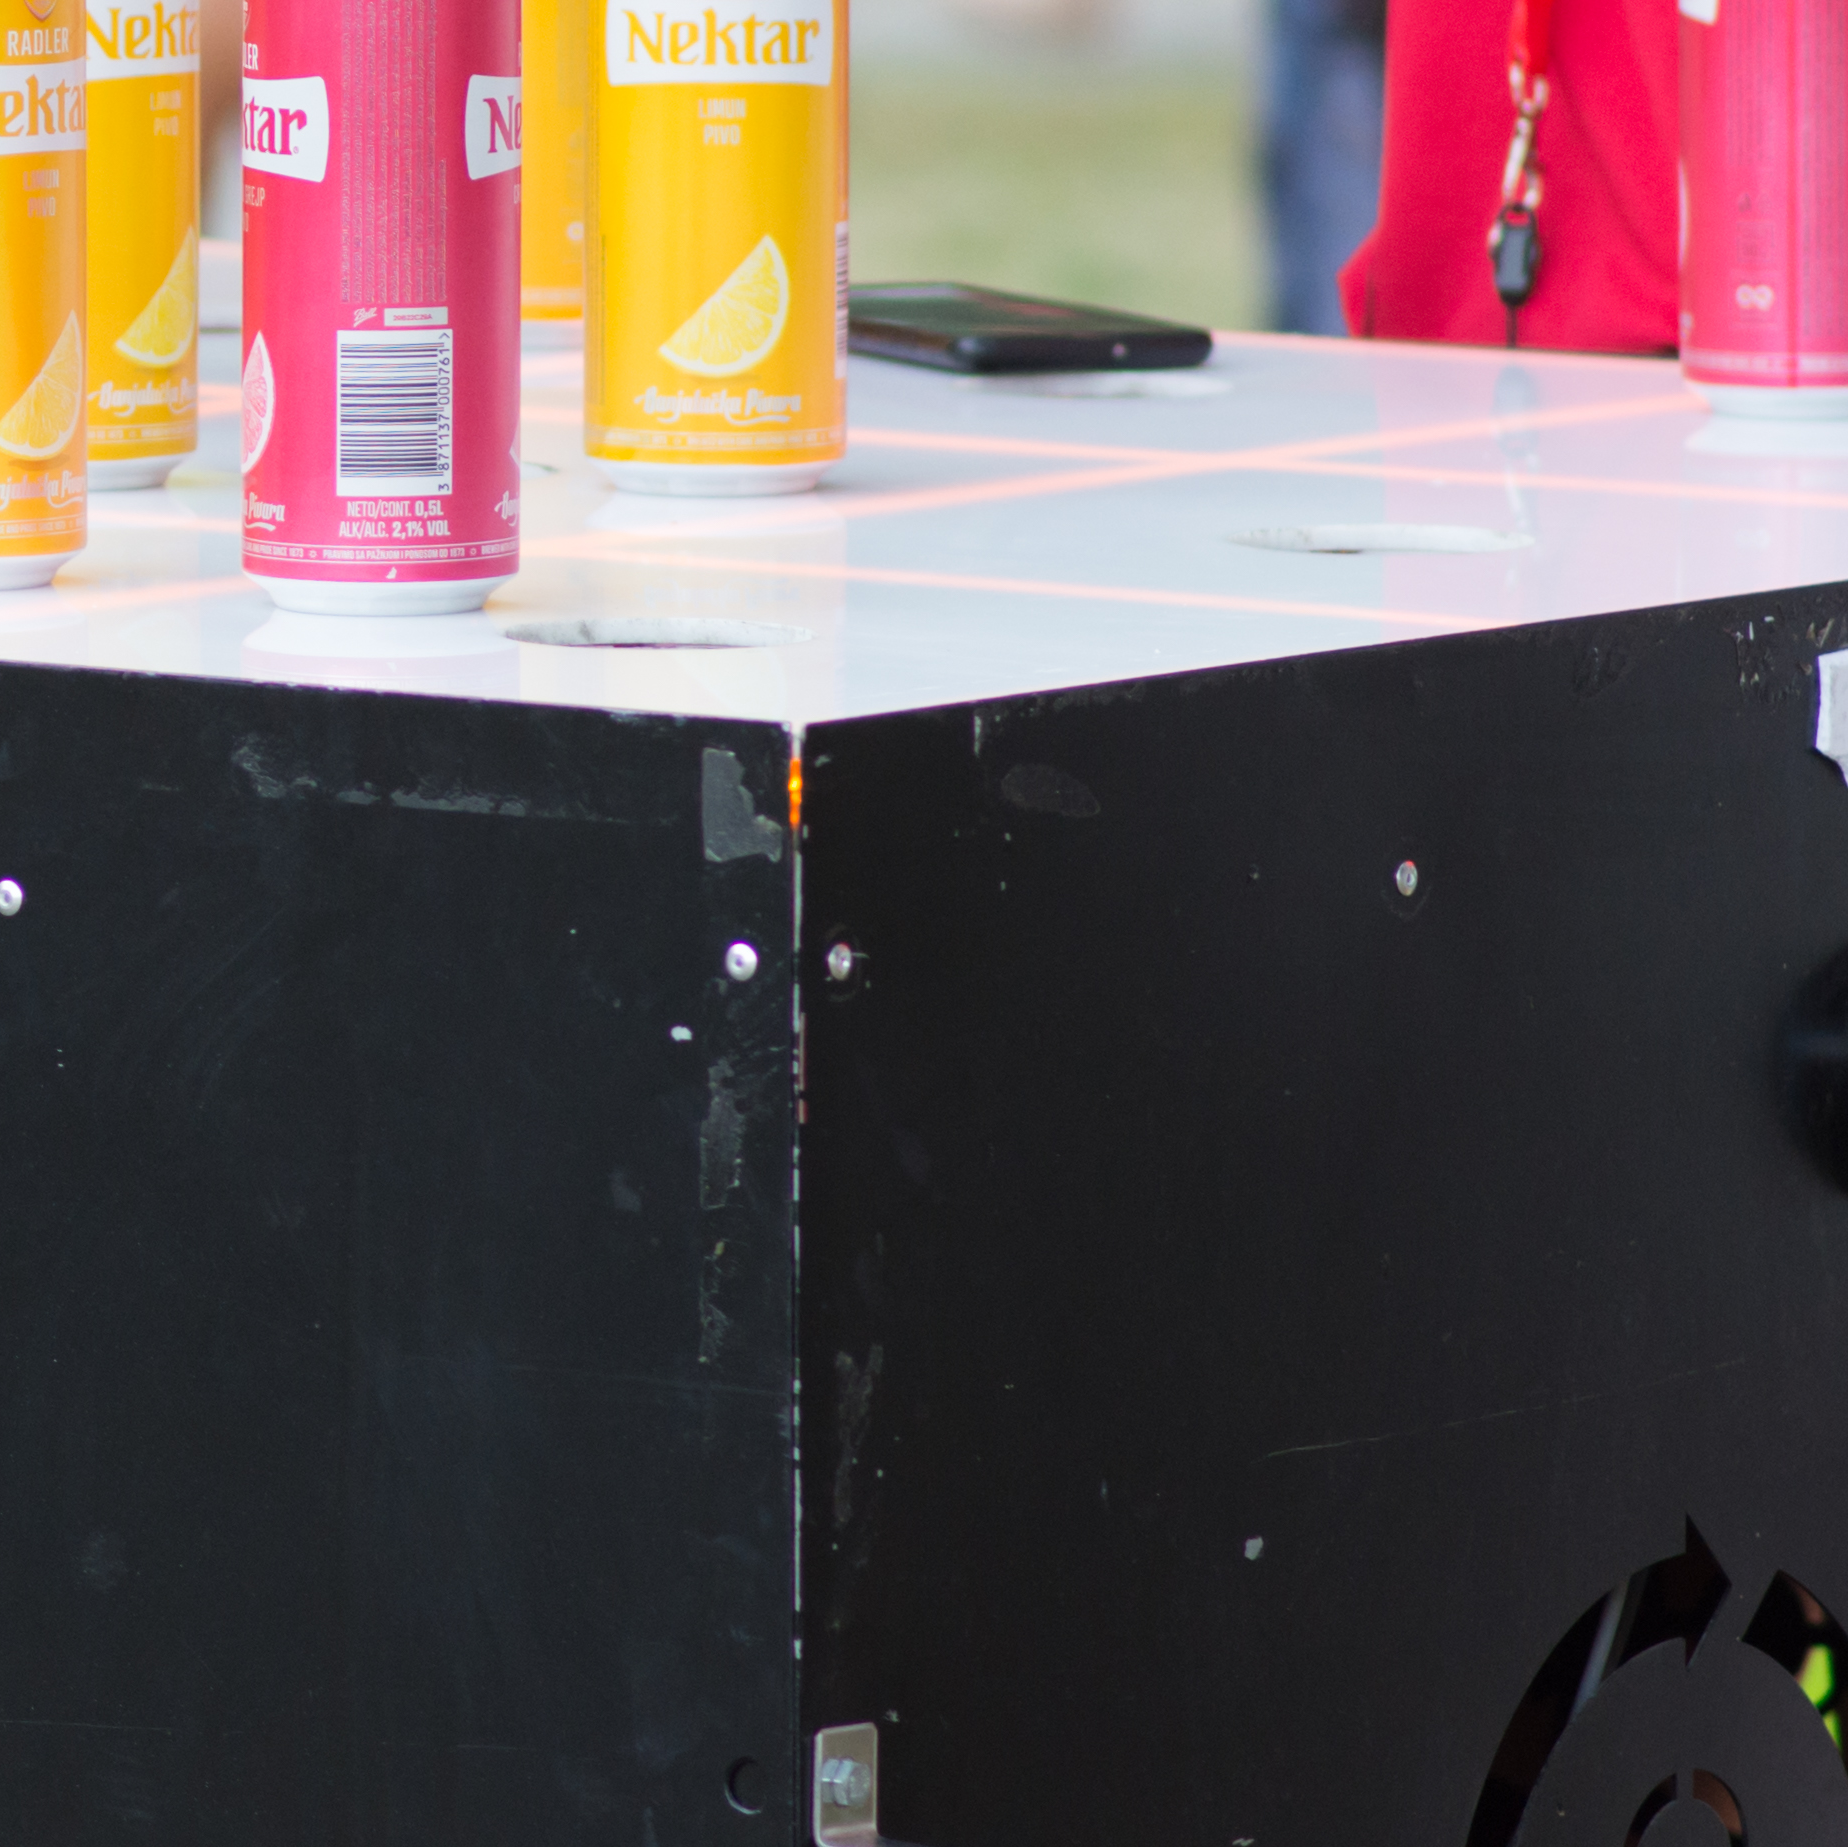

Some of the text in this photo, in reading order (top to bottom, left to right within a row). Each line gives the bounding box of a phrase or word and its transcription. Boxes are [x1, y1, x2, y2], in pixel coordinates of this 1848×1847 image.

[7, 27, 70, 57] RADLER
[622, 7, 821, 66] Nektar
[702, 123, 741, 145] PIVO
[438, 346, 451, 406] 000761
[438, 413, 451, 472] 871137
[346, 499, 444, 520] NETO/CONT. 0,5L
[339, 519, 451, 541] ALK/ALC. 2,1% VOL
